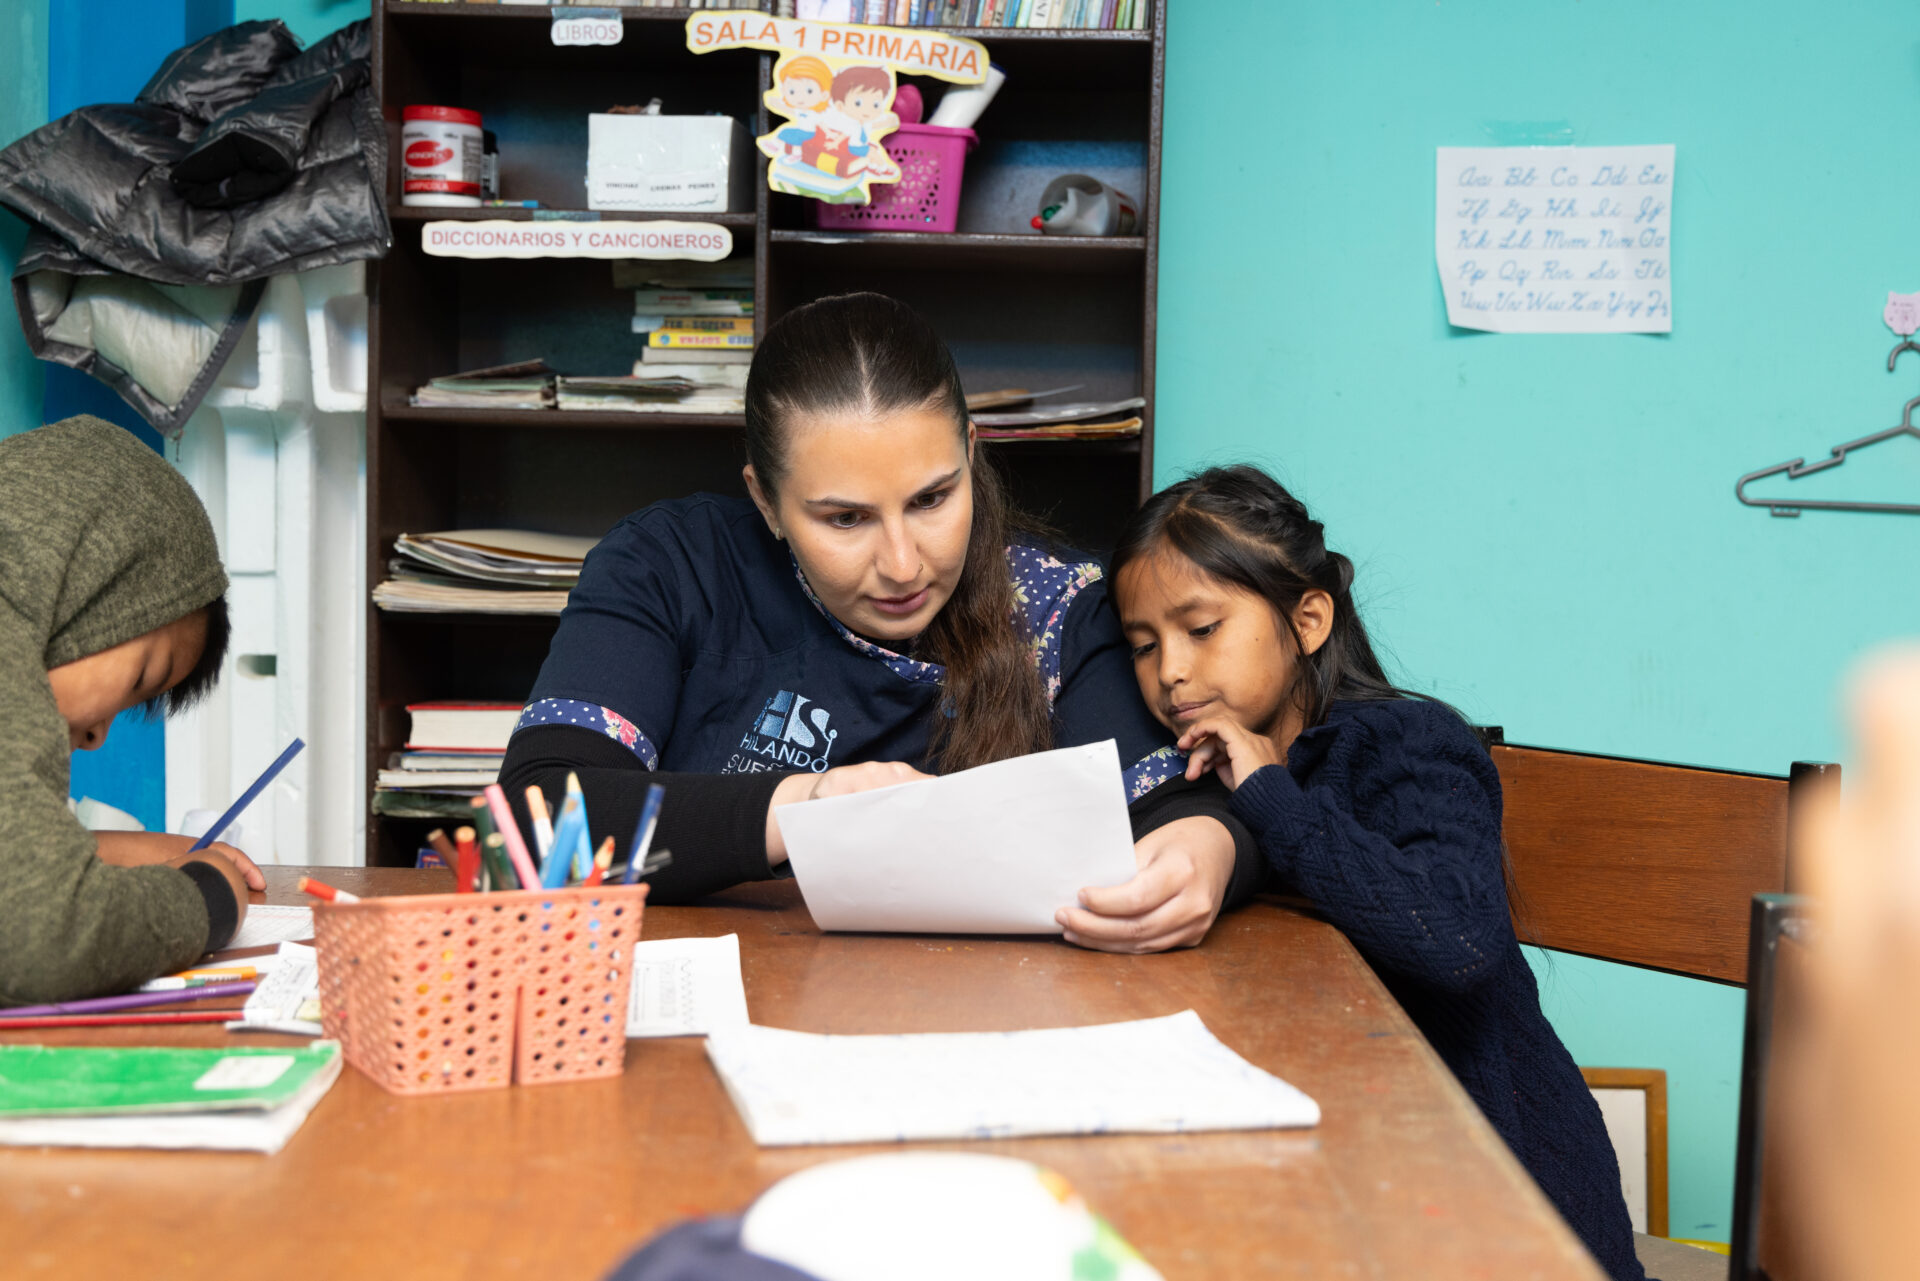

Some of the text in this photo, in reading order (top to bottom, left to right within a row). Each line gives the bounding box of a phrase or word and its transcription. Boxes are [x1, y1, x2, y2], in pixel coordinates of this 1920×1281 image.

[556, 24, 619, 41] LIBROS
[695, 20, 979, 76] SALA 1 PRIMARIA
[431, 230, 724, 250] DICCIONARIOS Y CANCIONEROS
[740, 732, 829, 773] HILANDO
